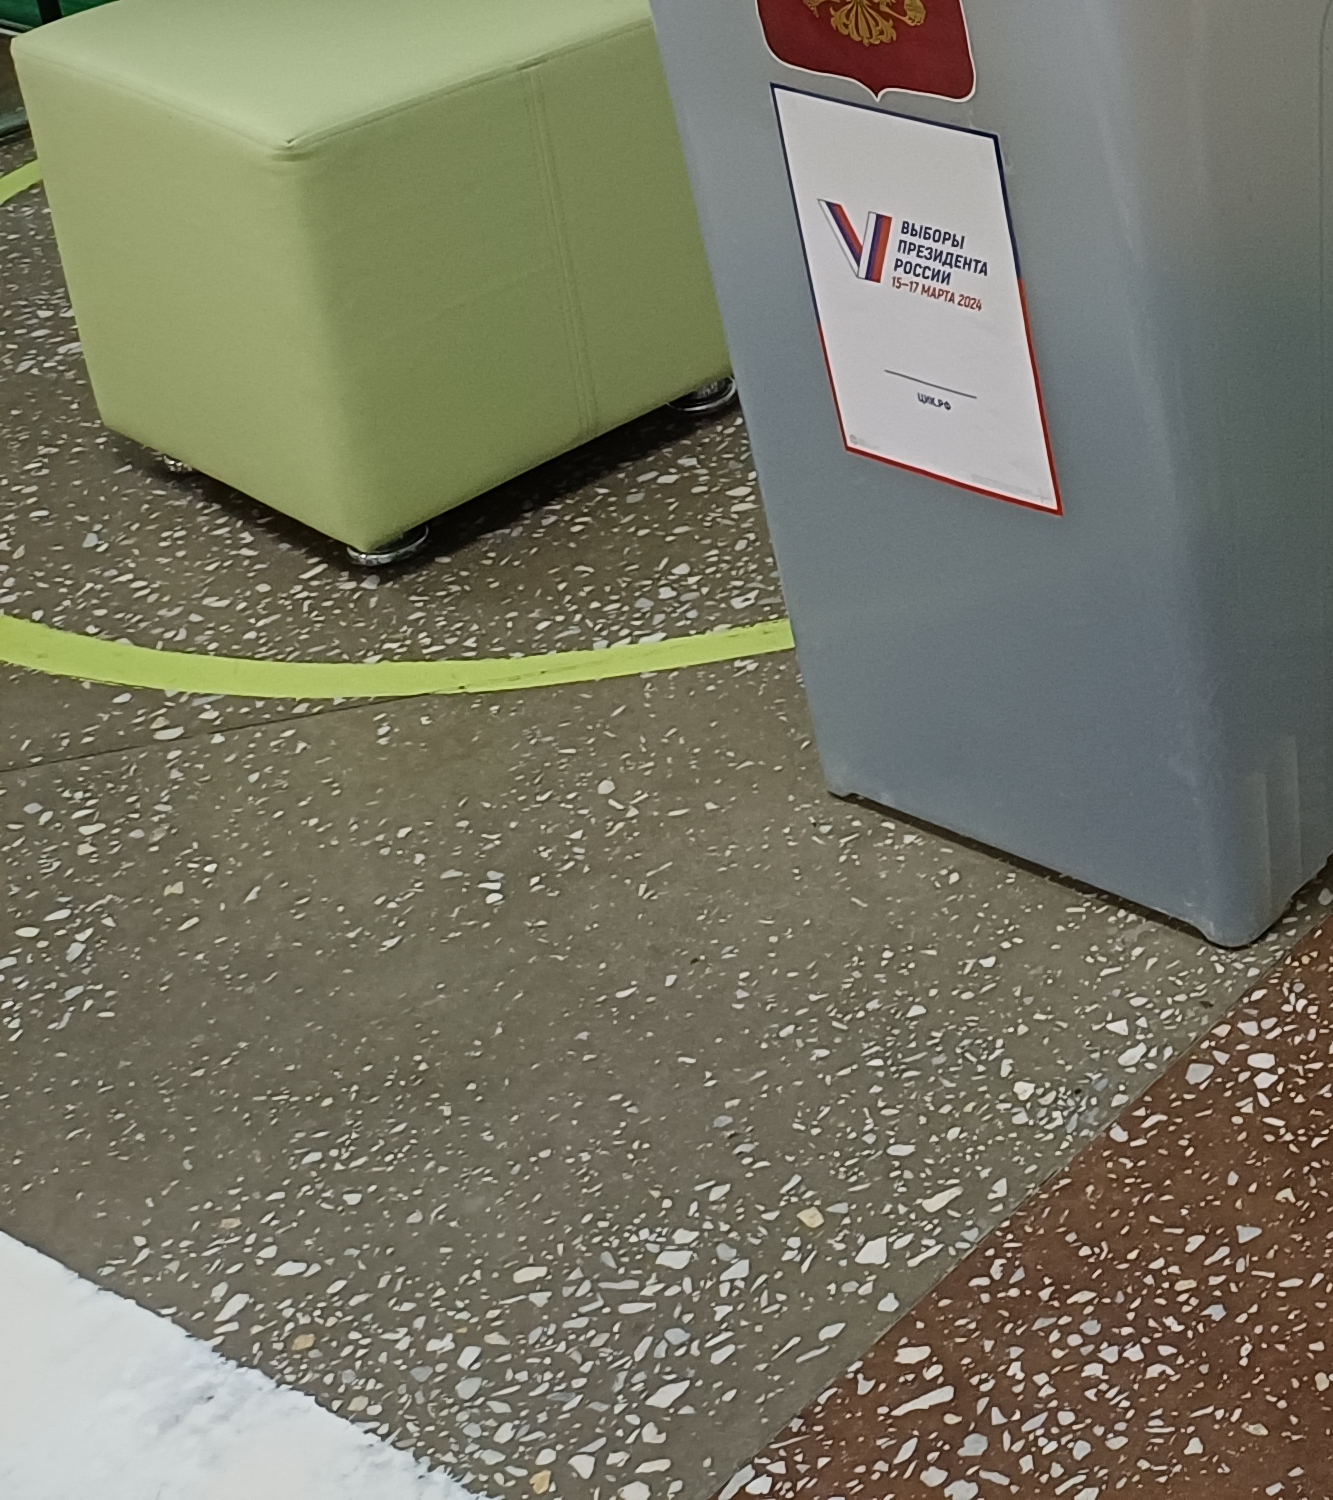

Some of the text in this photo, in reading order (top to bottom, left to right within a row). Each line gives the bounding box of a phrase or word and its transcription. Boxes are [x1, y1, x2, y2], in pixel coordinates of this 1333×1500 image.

[901, 220, 966, 249] ВЫБОРЫ
[893, 257, 952, 286] РОССИИ
[896, 239, 988, 277] ПРЕЗИДЕНТА
[920, 283, 955, 305] МАРТА
[957, 293, 982, 311] 2024
